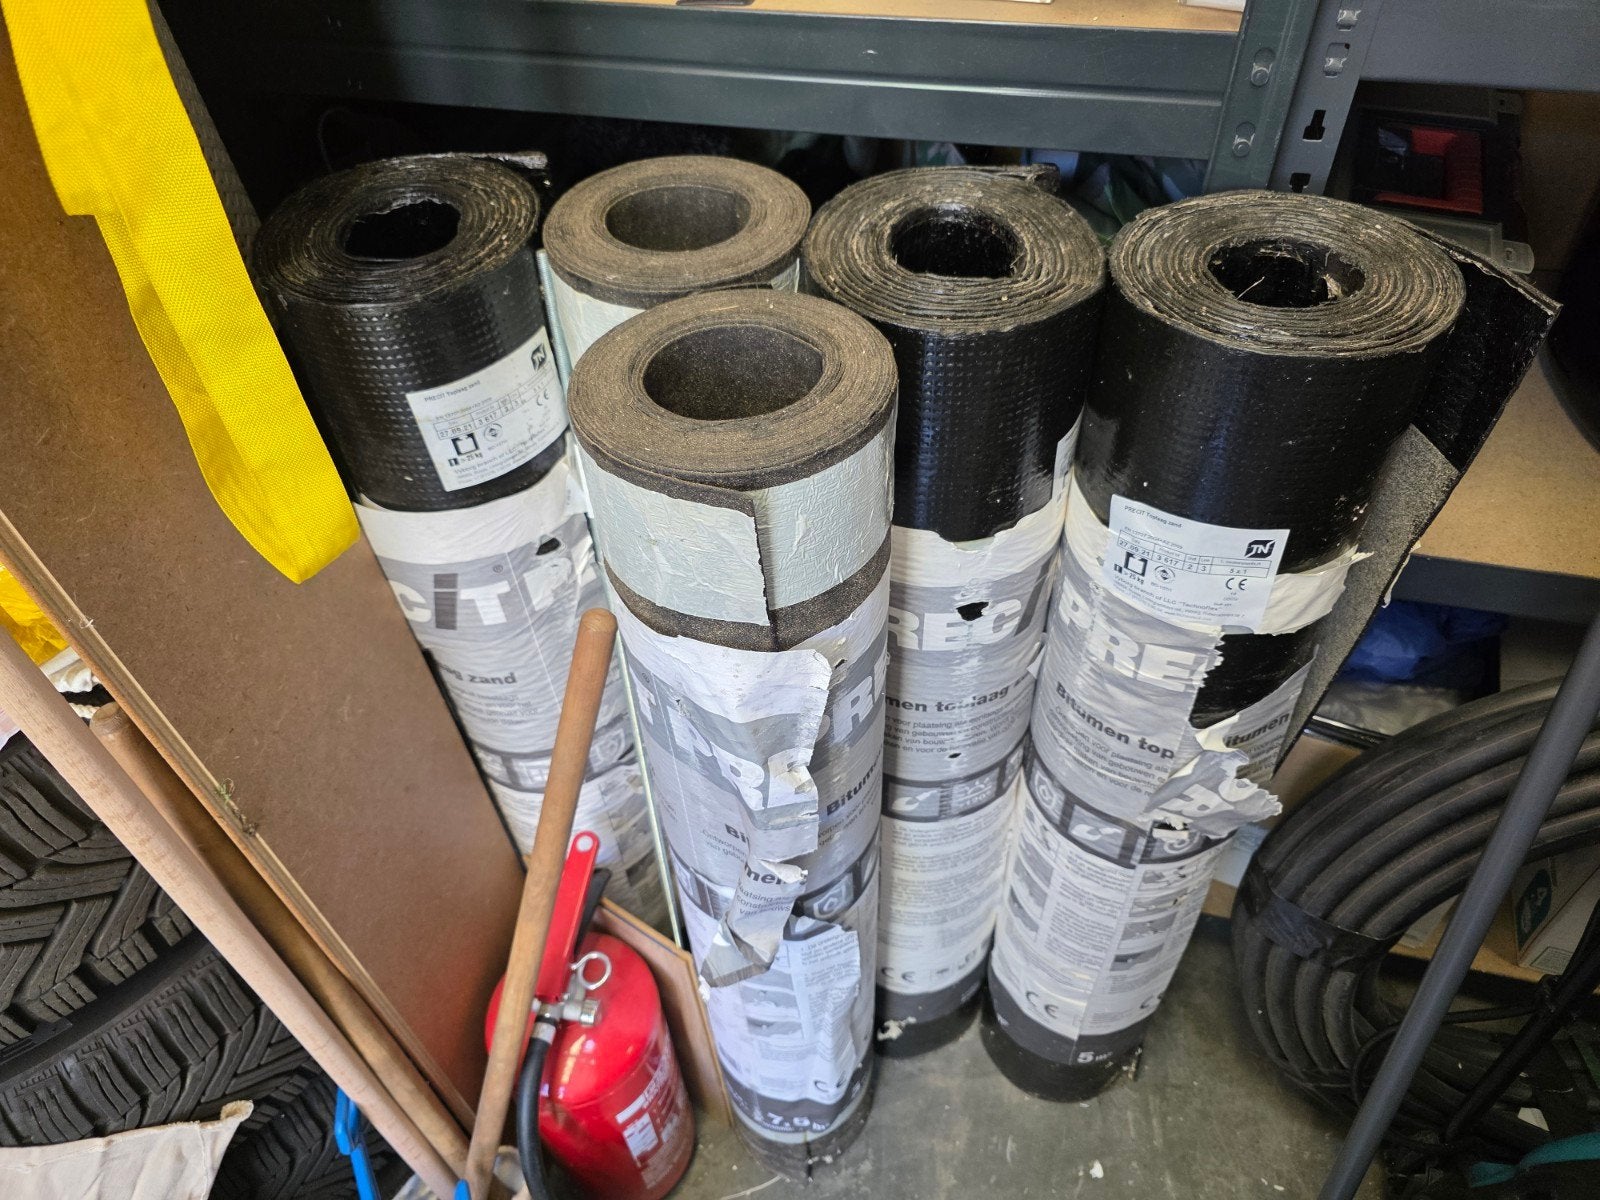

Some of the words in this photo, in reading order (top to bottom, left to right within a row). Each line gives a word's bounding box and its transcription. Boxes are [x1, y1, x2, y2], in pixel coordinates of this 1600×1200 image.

[1225, 577, 1248, 591] CE
[468, 671, 517, 685] zand
[1224, 712, 1290, 748] itumen
[1026, 991, 1059, 1019] CE
